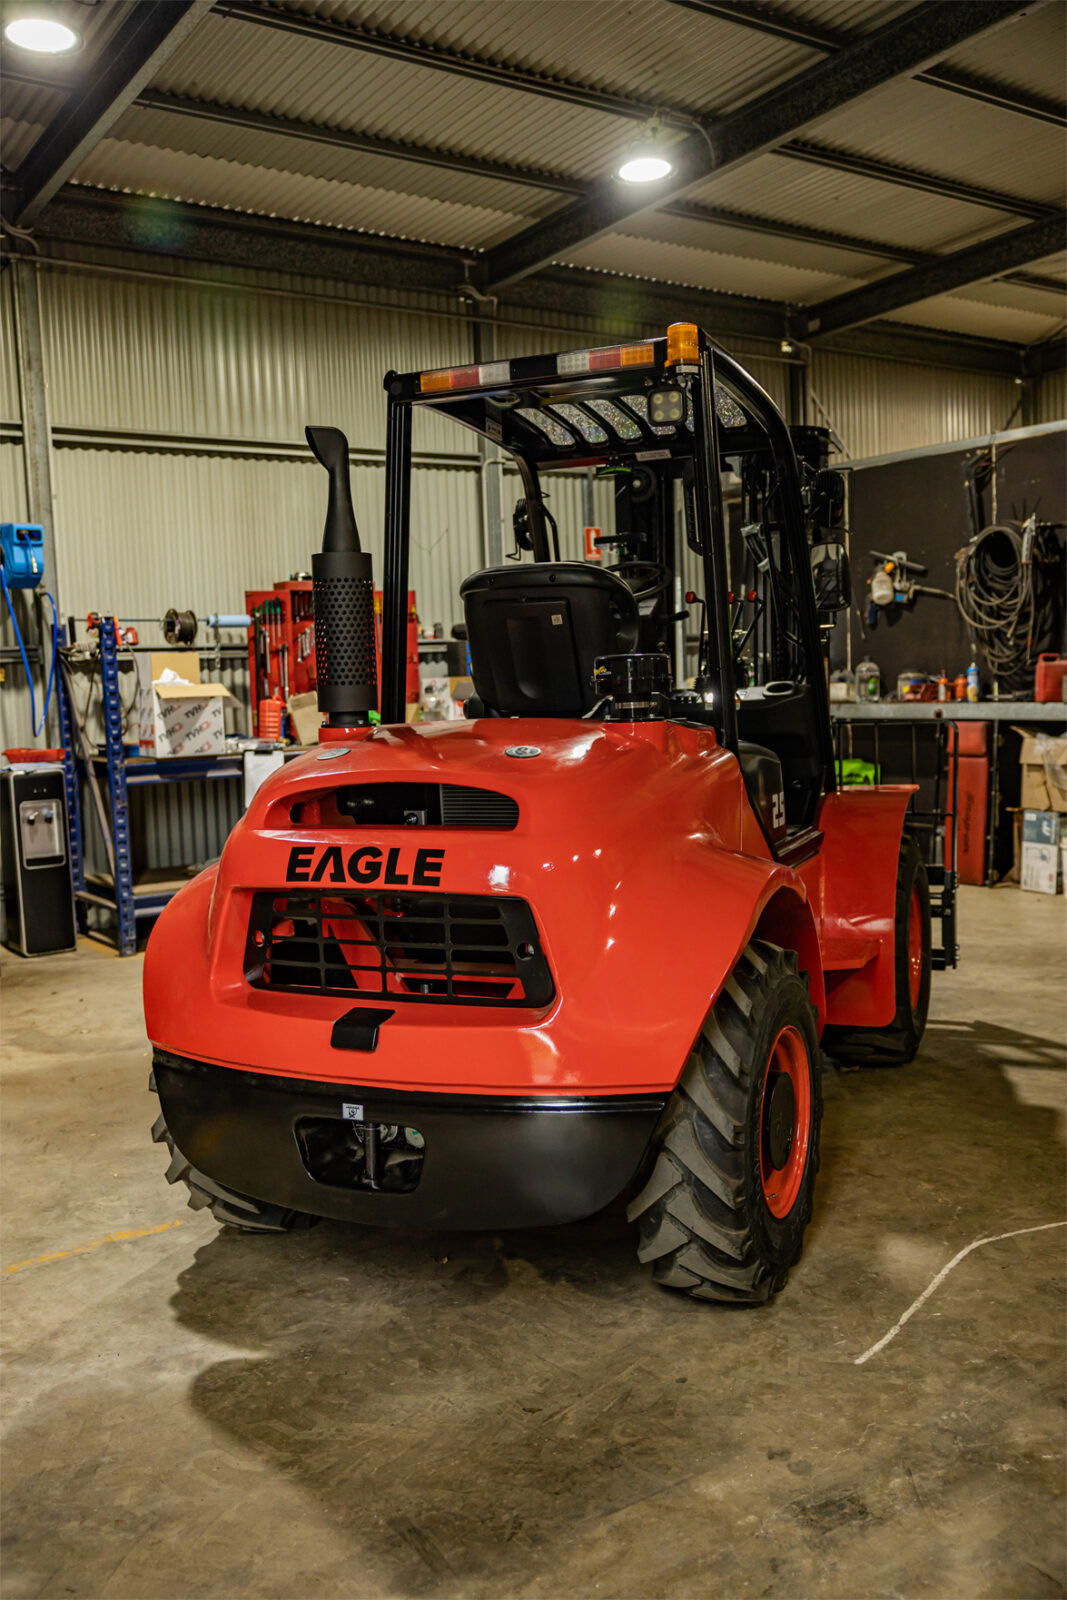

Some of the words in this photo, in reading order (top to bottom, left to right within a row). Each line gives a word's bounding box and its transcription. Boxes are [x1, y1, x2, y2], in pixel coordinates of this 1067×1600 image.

[184, 703, 202, 719] TVH
[185, 725, 203, 741] TVH
[772, 791, 785, 829] 25
[286, 846, 445, 886] EAGLE
